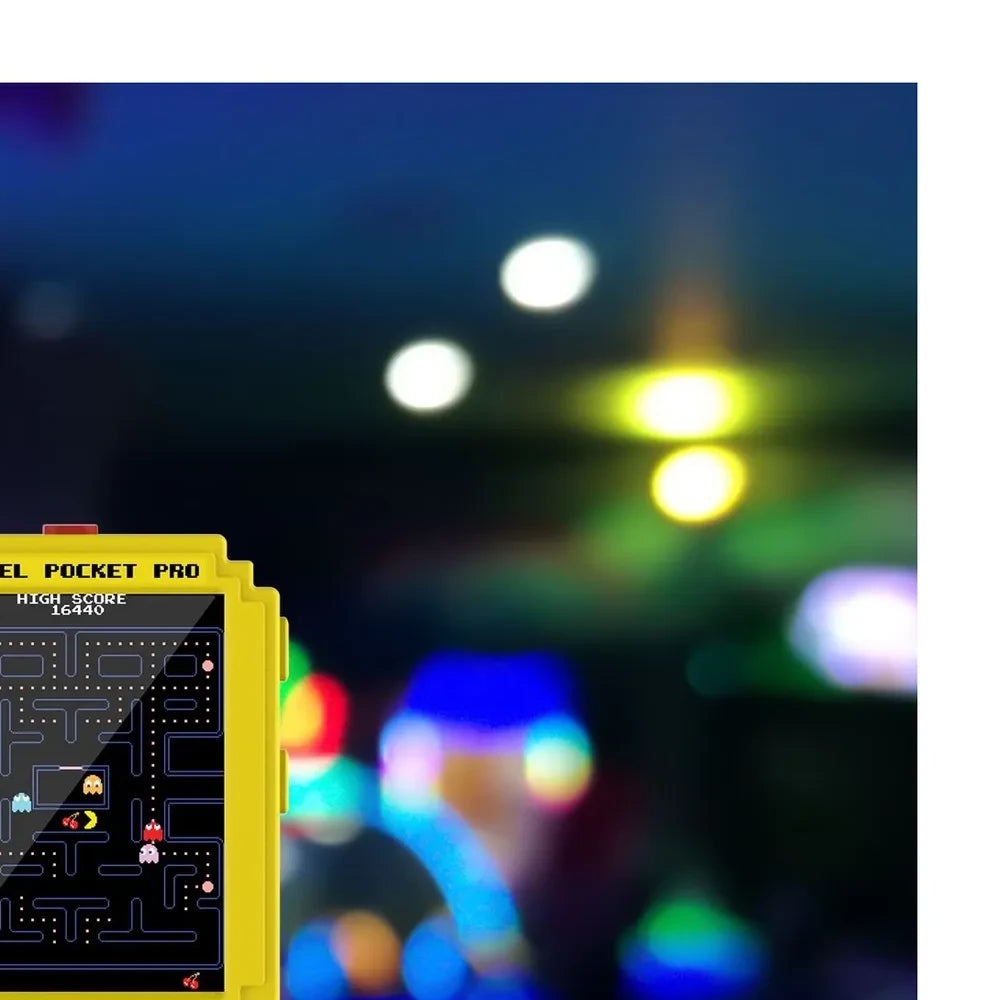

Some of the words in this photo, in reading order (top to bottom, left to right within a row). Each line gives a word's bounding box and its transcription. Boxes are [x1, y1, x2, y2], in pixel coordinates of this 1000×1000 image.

[44, 563, 138, 579] POCKET
[153, 563, 200, 579] PRO
[16, 593, 61, 605] HIGH
[71, 593, 127, 605] SCORE
[51, 604, 105, 616] 16440
